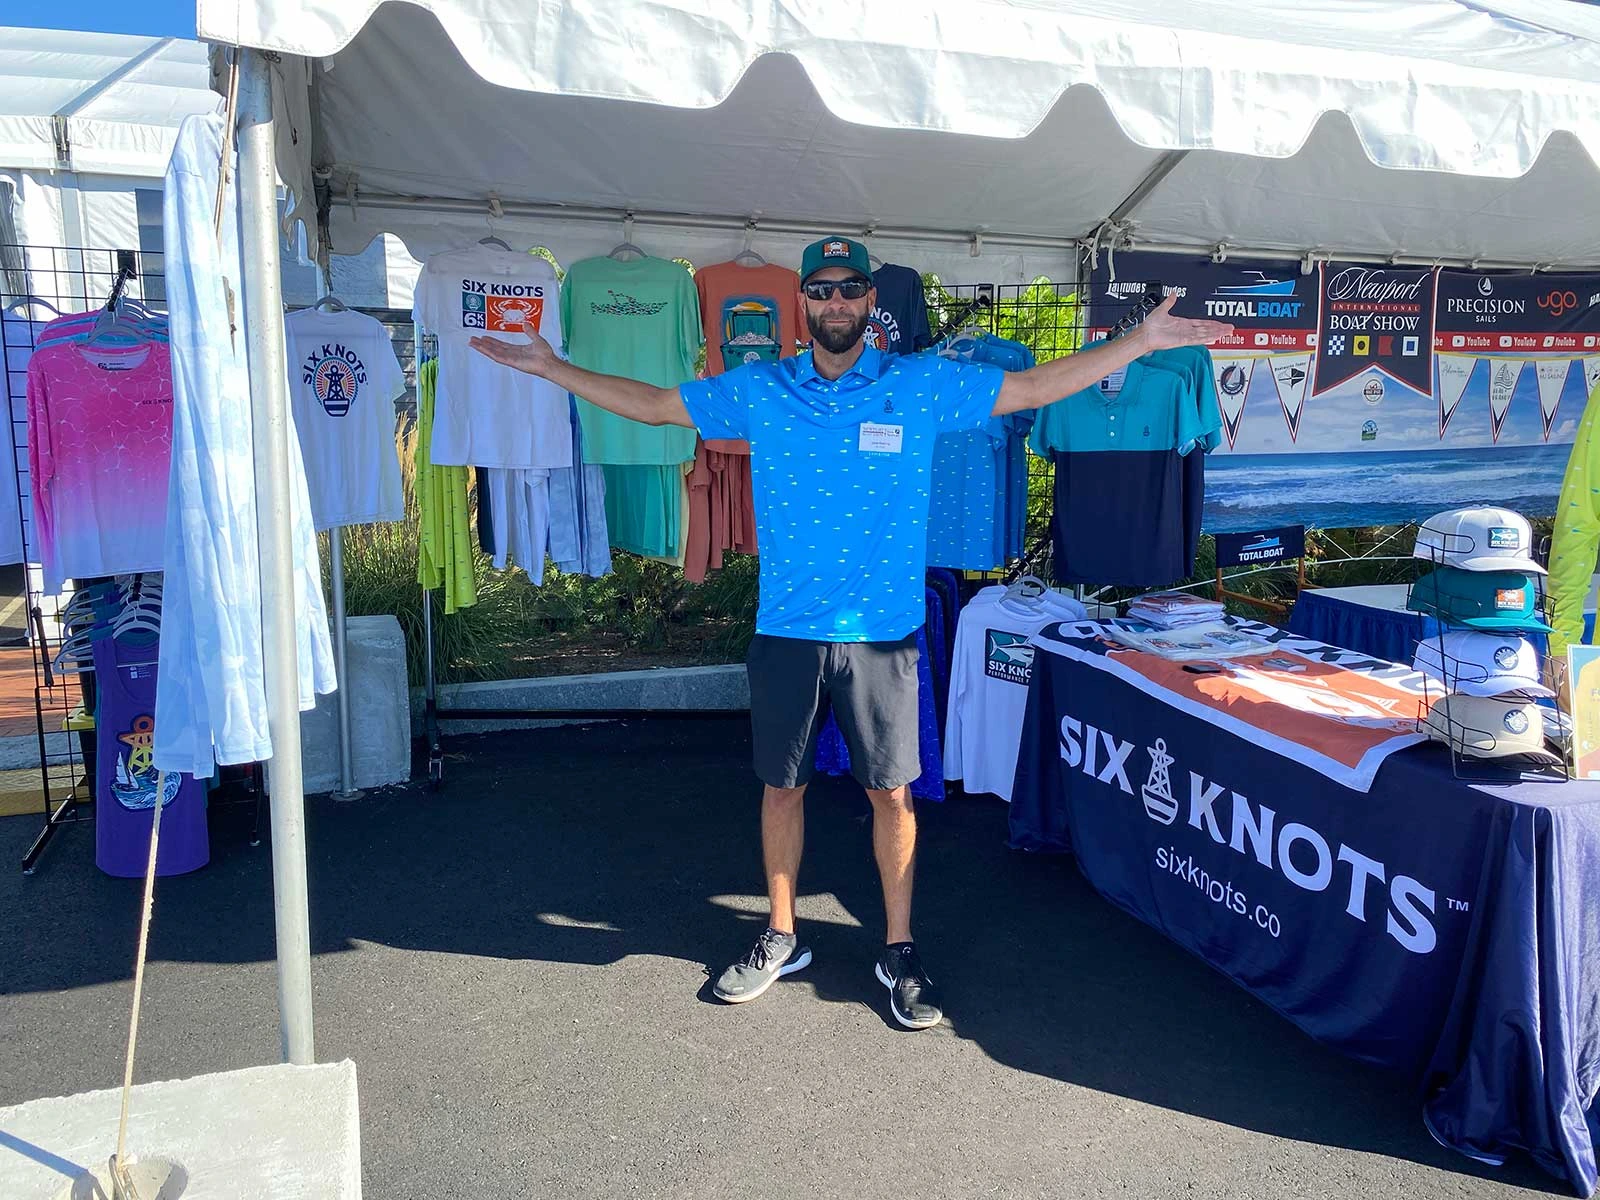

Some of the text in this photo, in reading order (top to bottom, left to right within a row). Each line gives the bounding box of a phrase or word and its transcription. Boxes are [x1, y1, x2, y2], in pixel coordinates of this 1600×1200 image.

[462, 279, 544, 297] SIX KNOTS
[1326, 267, 1430, 303] Newport
[1205, 301, 1302, 318] TOTALBOAT
[1333, 303, 1419, 311] INTERNATIONAL
[1447, 298, 1525, 314] PRECISION
[870, 306, 901, 342] NOTS
[1329, 311, 1420, 331] BOAT SHOW
[1475, 315, 1497, 323] SAILS
[1270, 335, 1297, 345] YouTube
[1466, 336, 1576, 347] YouTube YouTube YouTube
[303, 343, 368, 385] SIX KNOTS
[988, 660, 1033, 679] SIX KNO
[988, 669, 1024, 684] PERFORMANCE
[1060, 714, 1135, 796] SIX
[1187, 770, 1437, 953] KNOTS
[1155, 846, 1281, 938] sixknots.co
